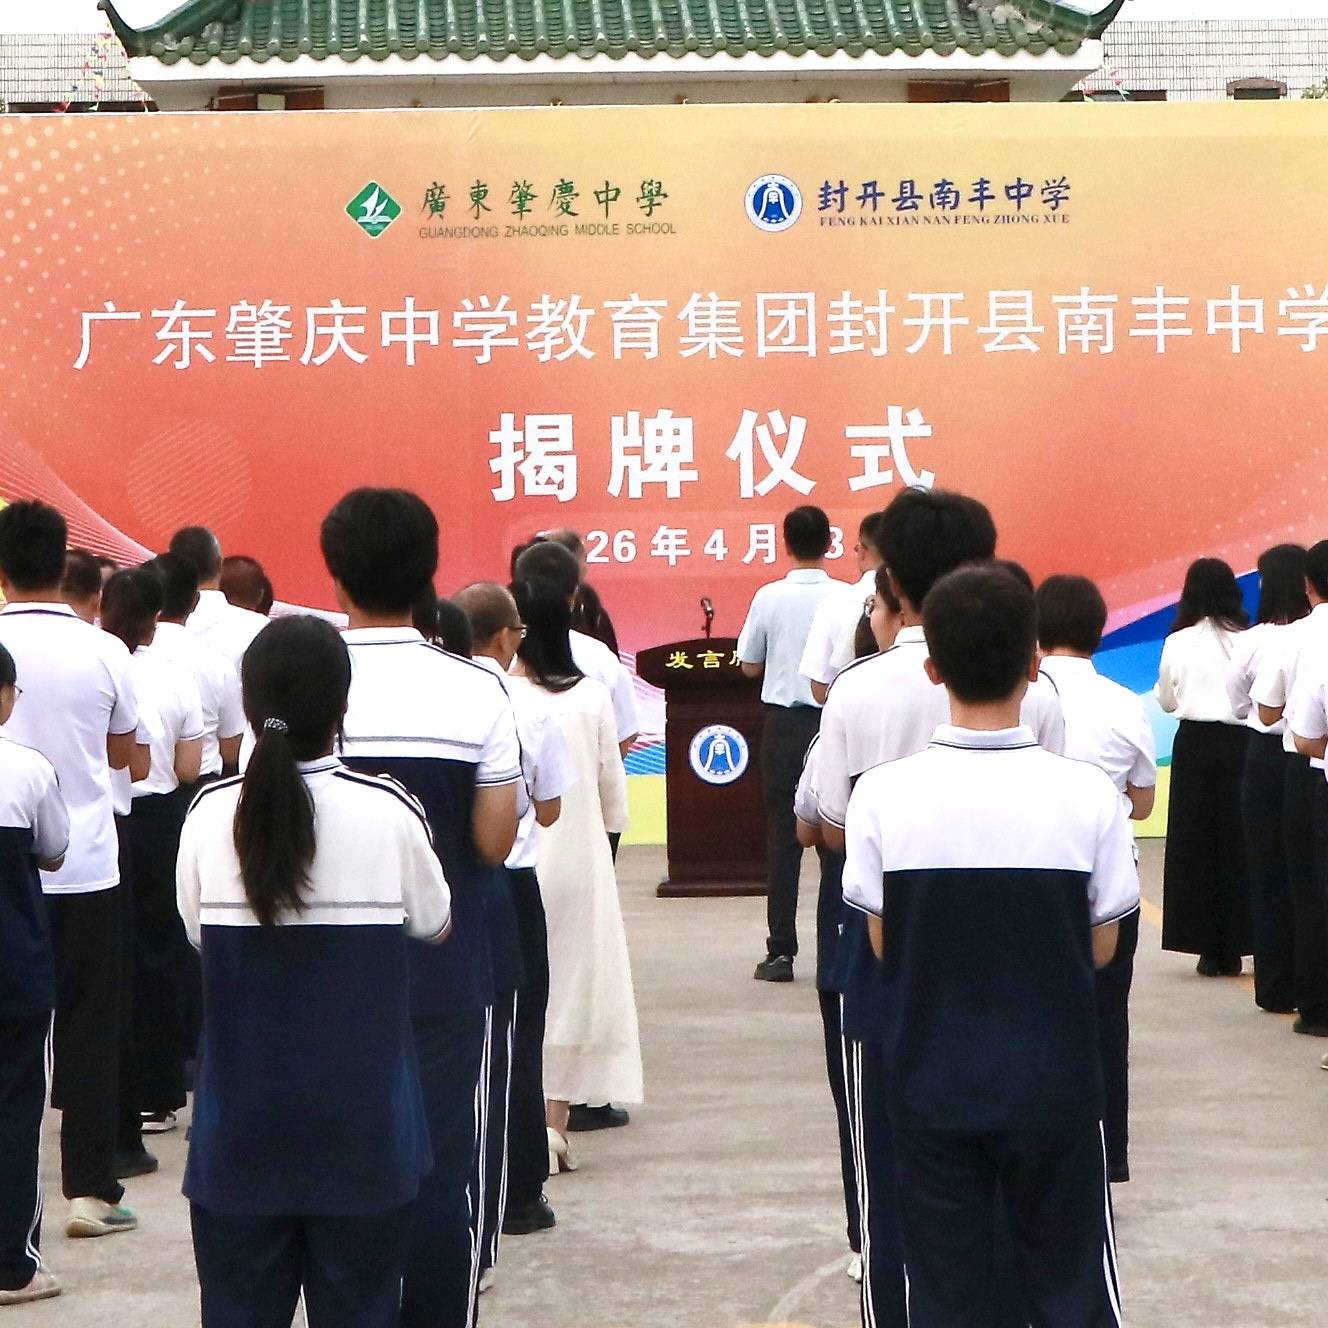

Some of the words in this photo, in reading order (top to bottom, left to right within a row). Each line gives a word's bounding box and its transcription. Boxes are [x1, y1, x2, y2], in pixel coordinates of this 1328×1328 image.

[419, 177, 669, 220] 廣東肇慶中學
[817, 176, 1071, 213] 封开县南丰中学
[419, 225, 499, 239] GUANGDONG
[504, 224, 569, 238] ZHAOQING
[575, 223, 619, 236] MIDDLE
[626, 222, 677, 235] SCHOOL
[820, 217, 856, 227] FENG
[859, 217, 883, 226] KAI
[887, 216, 920, 226] XIAN
[923, 215, 951, 225] NAN
[954, 215, 990, 225] FENG
[994, 214, 1039, 224] ZHONG
[489, 404, 936, 502] 揭牌仪式
